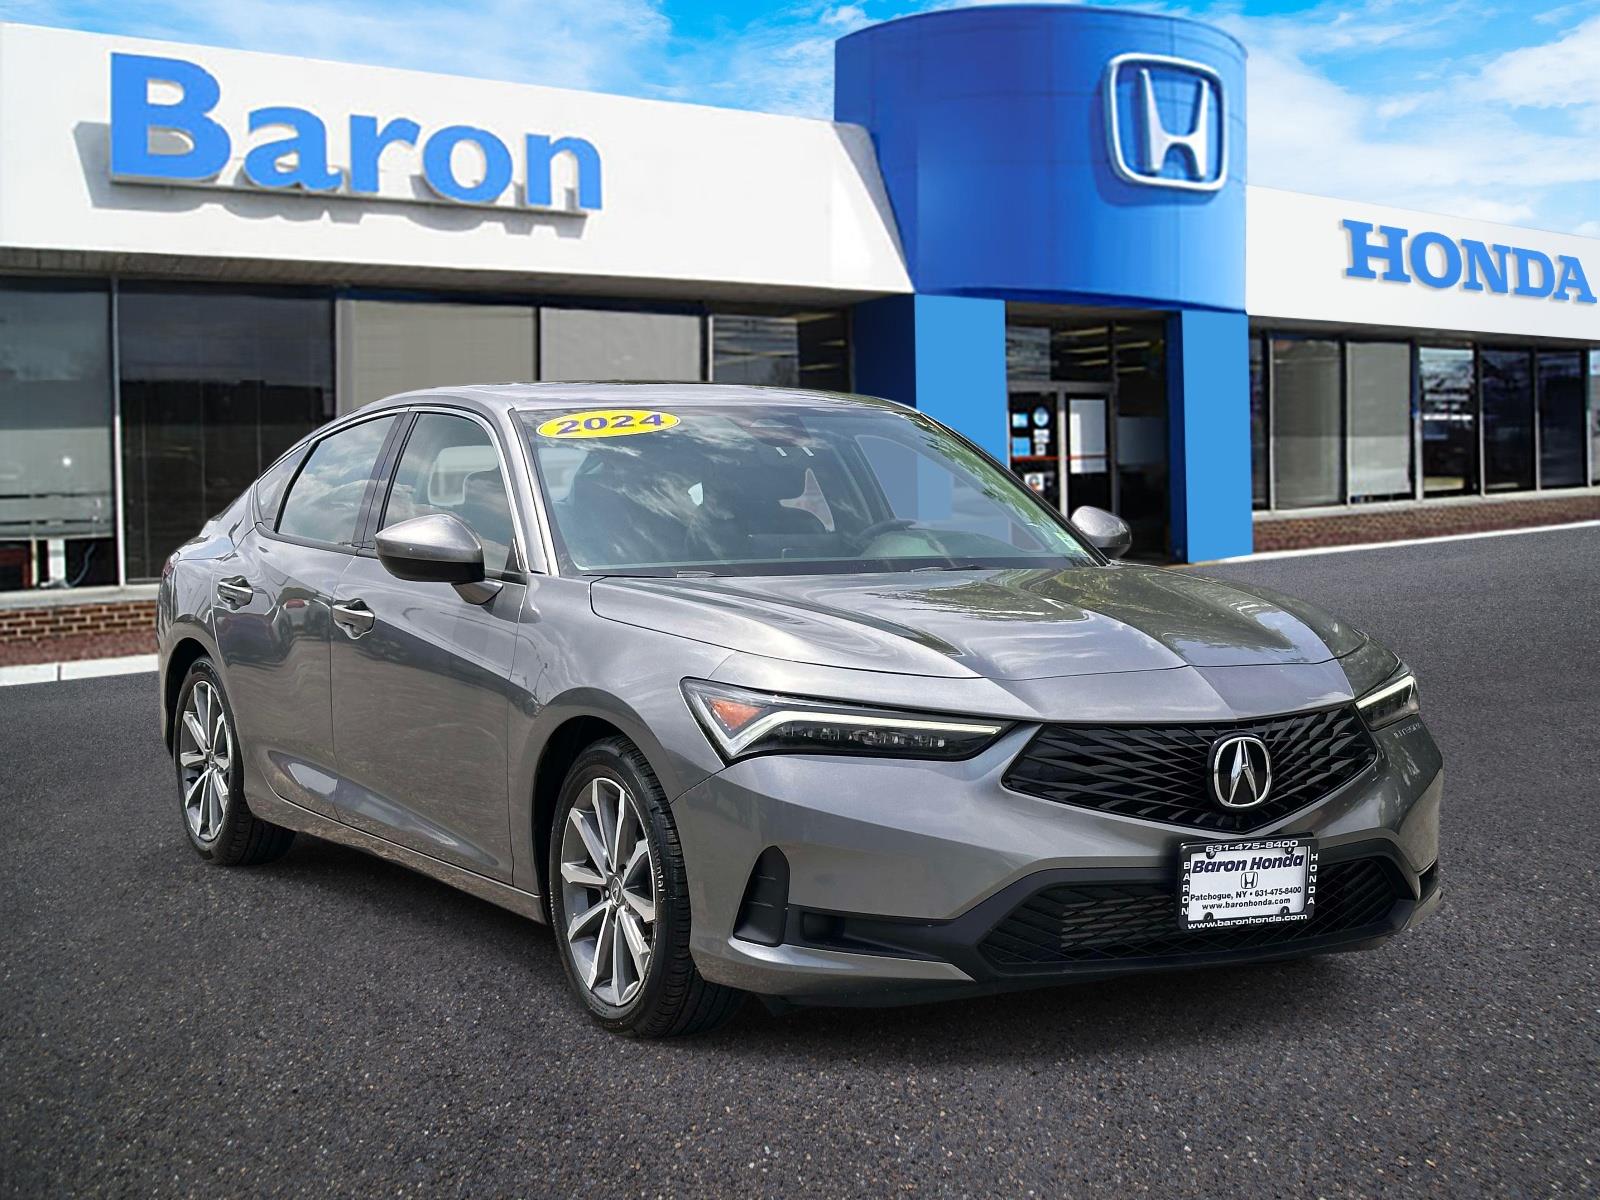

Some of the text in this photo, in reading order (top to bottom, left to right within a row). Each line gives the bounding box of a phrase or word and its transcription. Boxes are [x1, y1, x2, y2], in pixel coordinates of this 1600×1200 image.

[110, 52, 602, 210] Baron
[1341, 218, 1598, 304] HONDA
[556, 413, 665, 435] 2024
[1205, 839, 1299, 852] 631-475-8400
[1191, 853, 1304, 874] Baron Honda
[1181, 861, 1190, 916] BARON
[1307, 853, 1319, 905] HONDA
[1190, 892, 1234, 902] Patchogue,
[1235, 891, 1247, 899] NY
[1201, 897, 1291, 910] www.baronhonda.com
[1187, 912, 1308, 929] www.baronhonda.com
